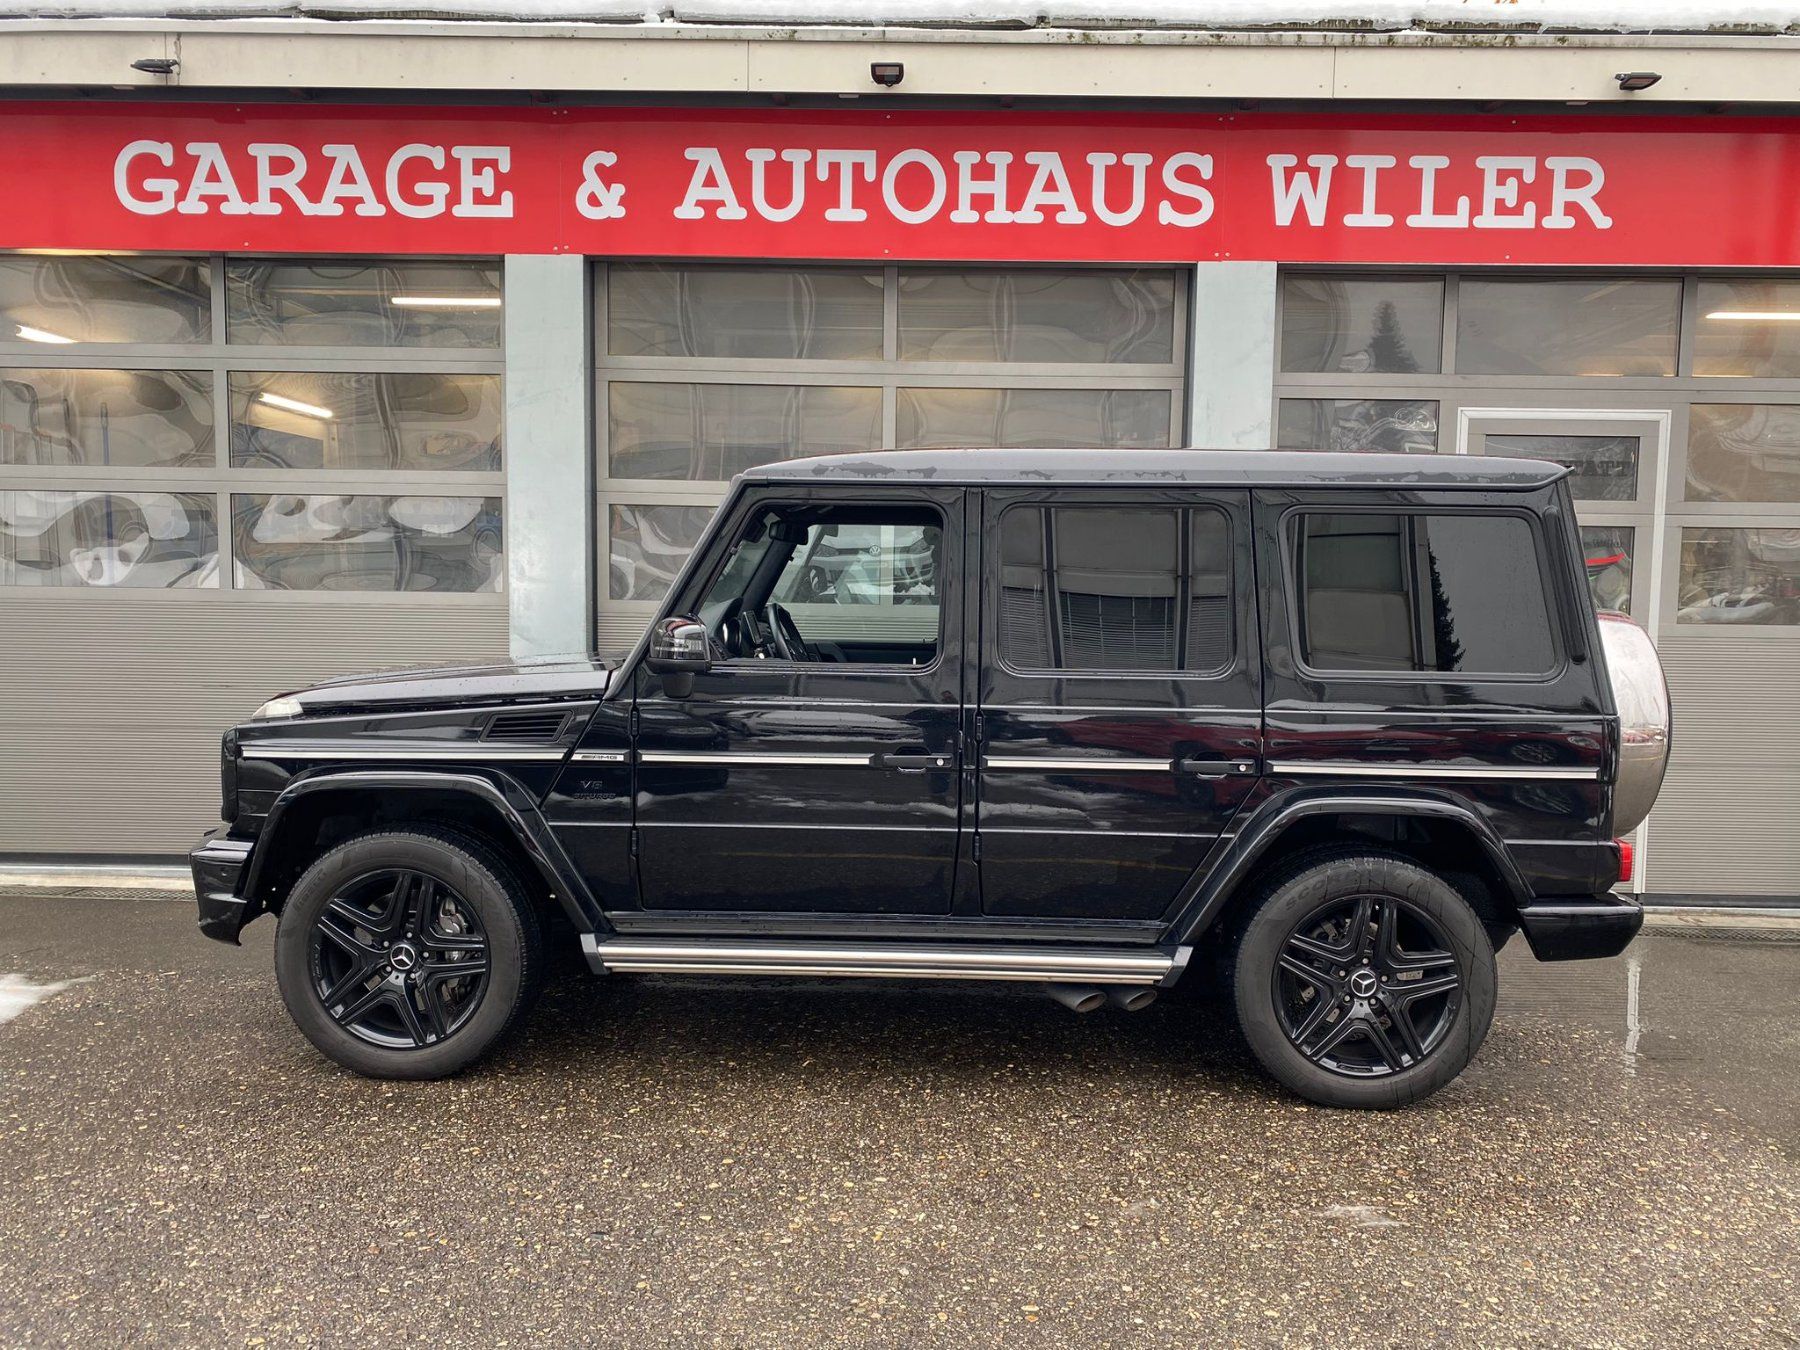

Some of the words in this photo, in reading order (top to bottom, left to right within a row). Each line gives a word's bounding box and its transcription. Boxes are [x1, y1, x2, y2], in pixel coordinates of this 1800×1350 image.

[113, 140, 514, 219] GARAGE
[575, 150, 626, 221] &
[673, 147, 1215, 228] AUTOHAUS
[1266, 154, 1613, 230] WILER
